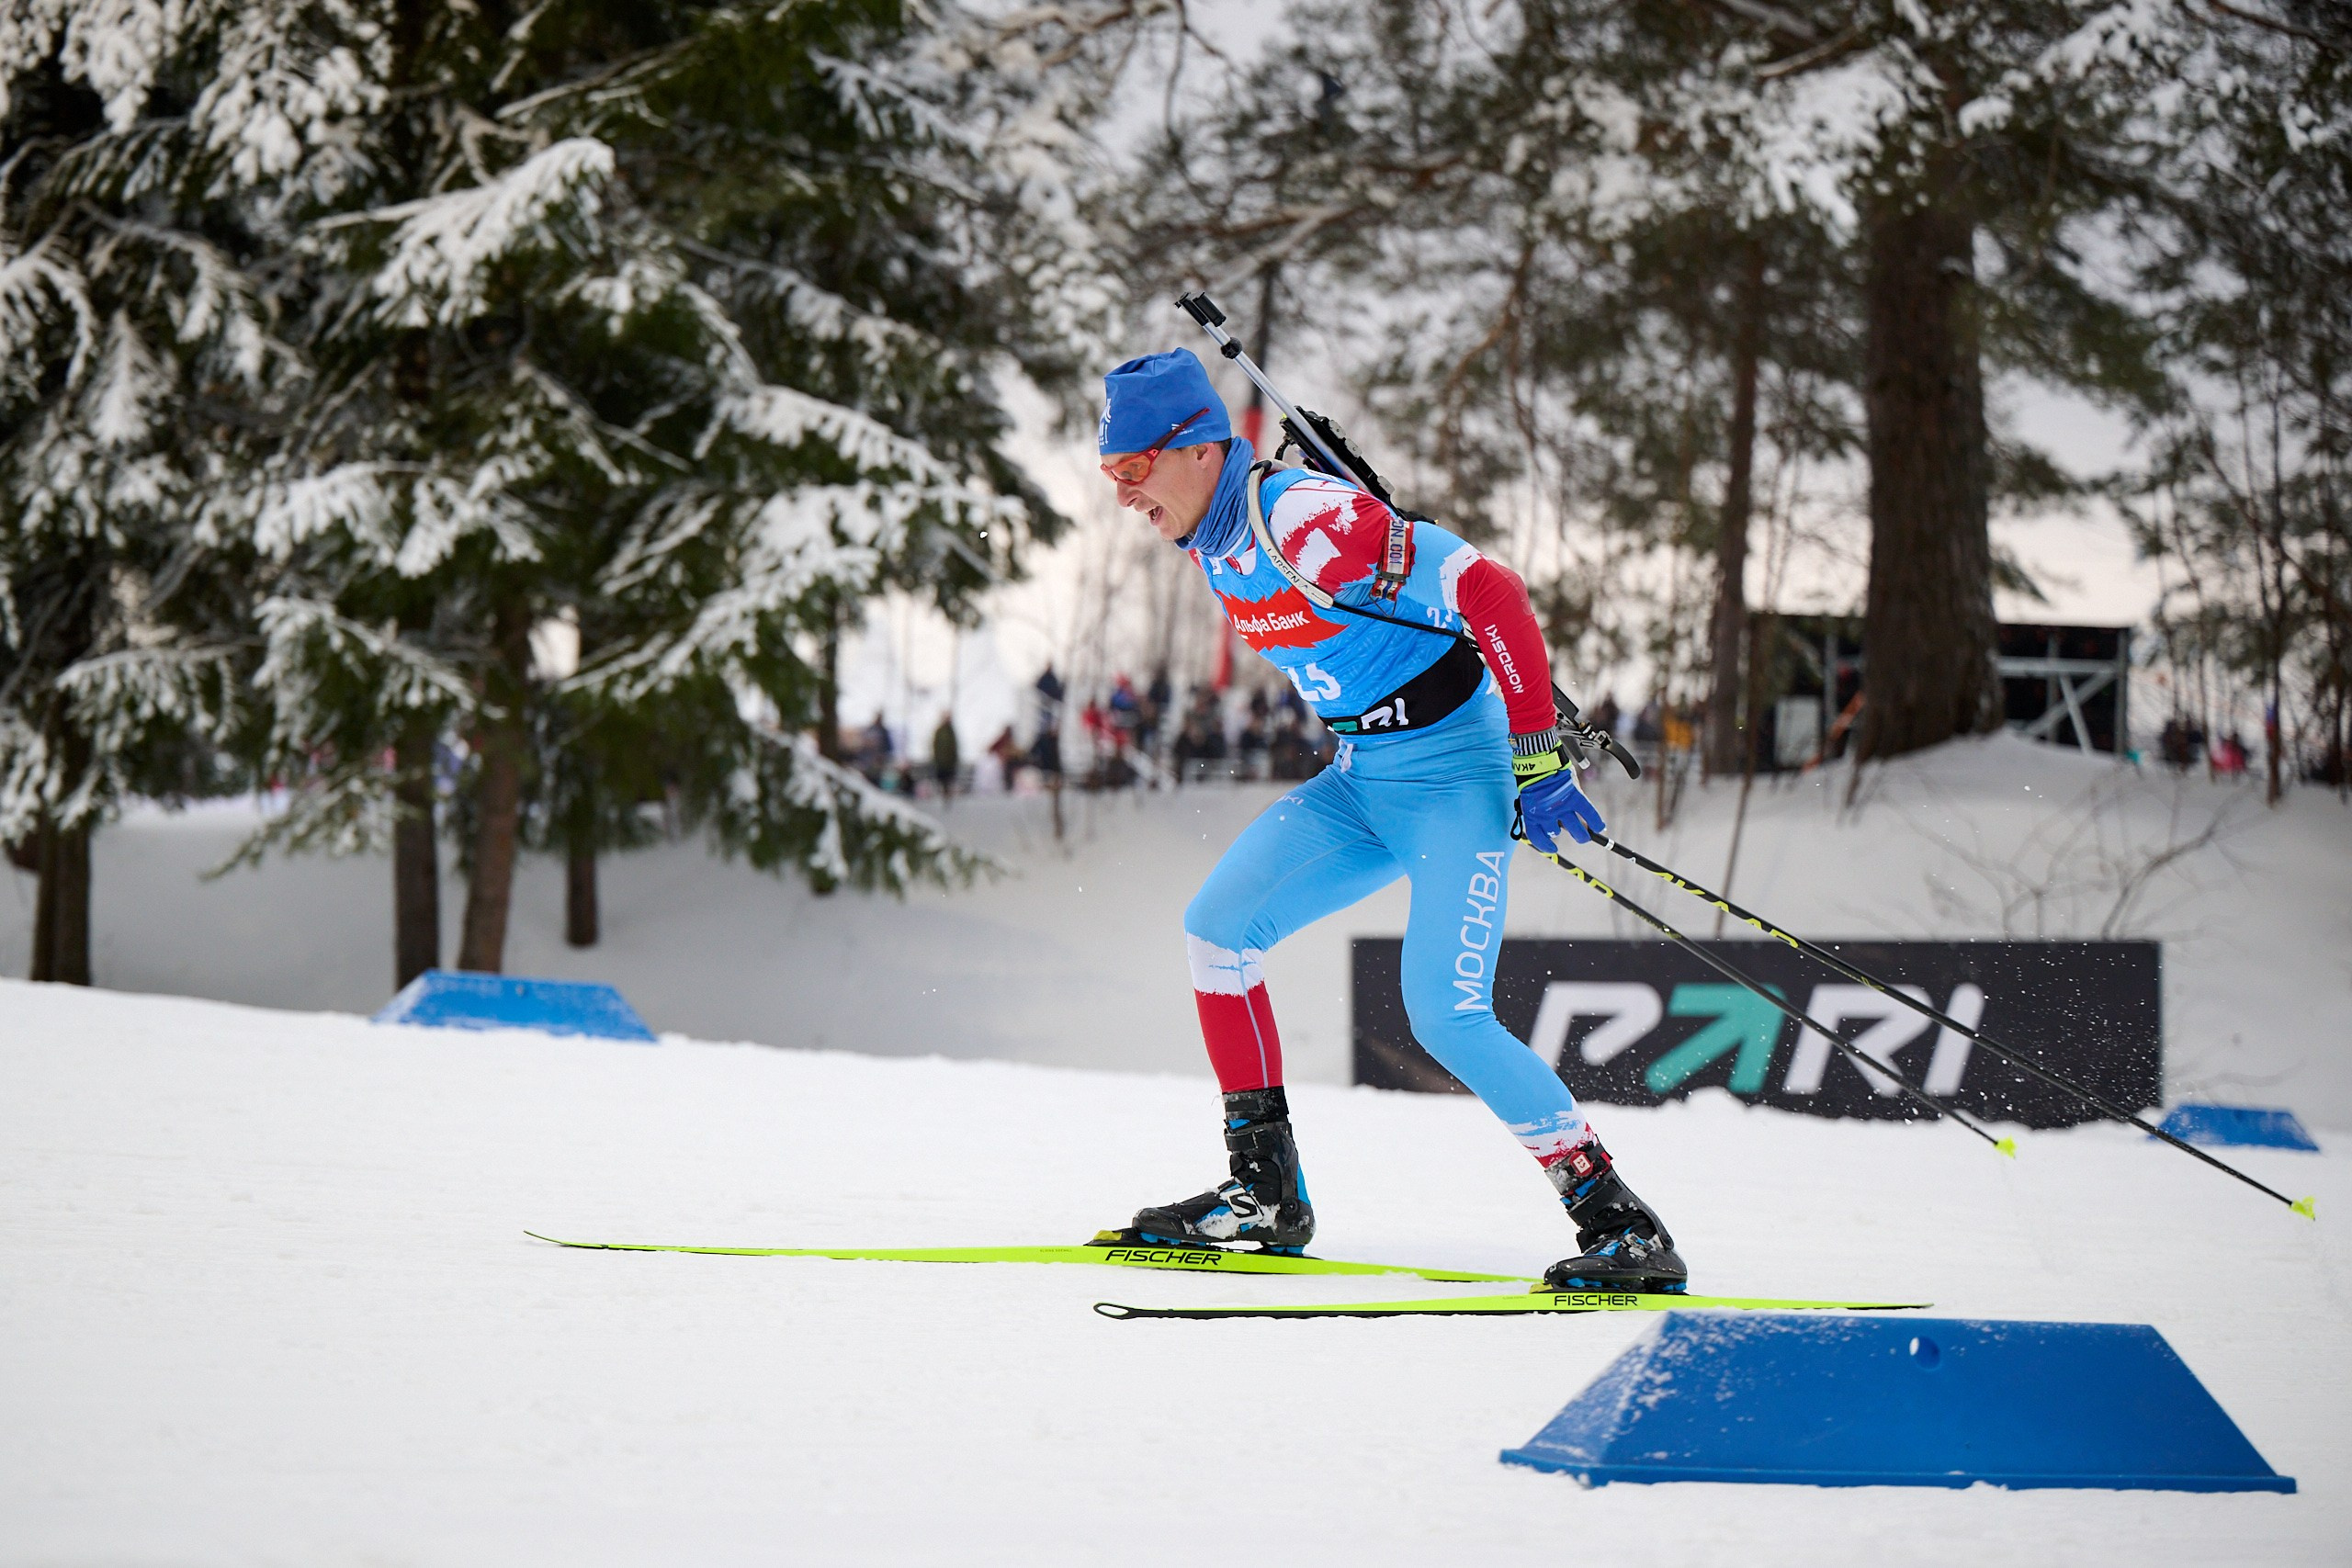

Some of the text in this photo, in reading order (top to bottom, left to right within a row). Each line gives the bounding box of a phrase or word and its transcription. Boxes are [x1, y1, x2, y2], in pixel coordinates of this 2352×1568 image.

[1485, 624, 1524, 694] NORDSKI
[1453, 851, 1505, 1011] МОСКВА
[1104, 1249, 1222, 1266] FISCHER
[1554, 1294, 1638, 1306] FISCHER
